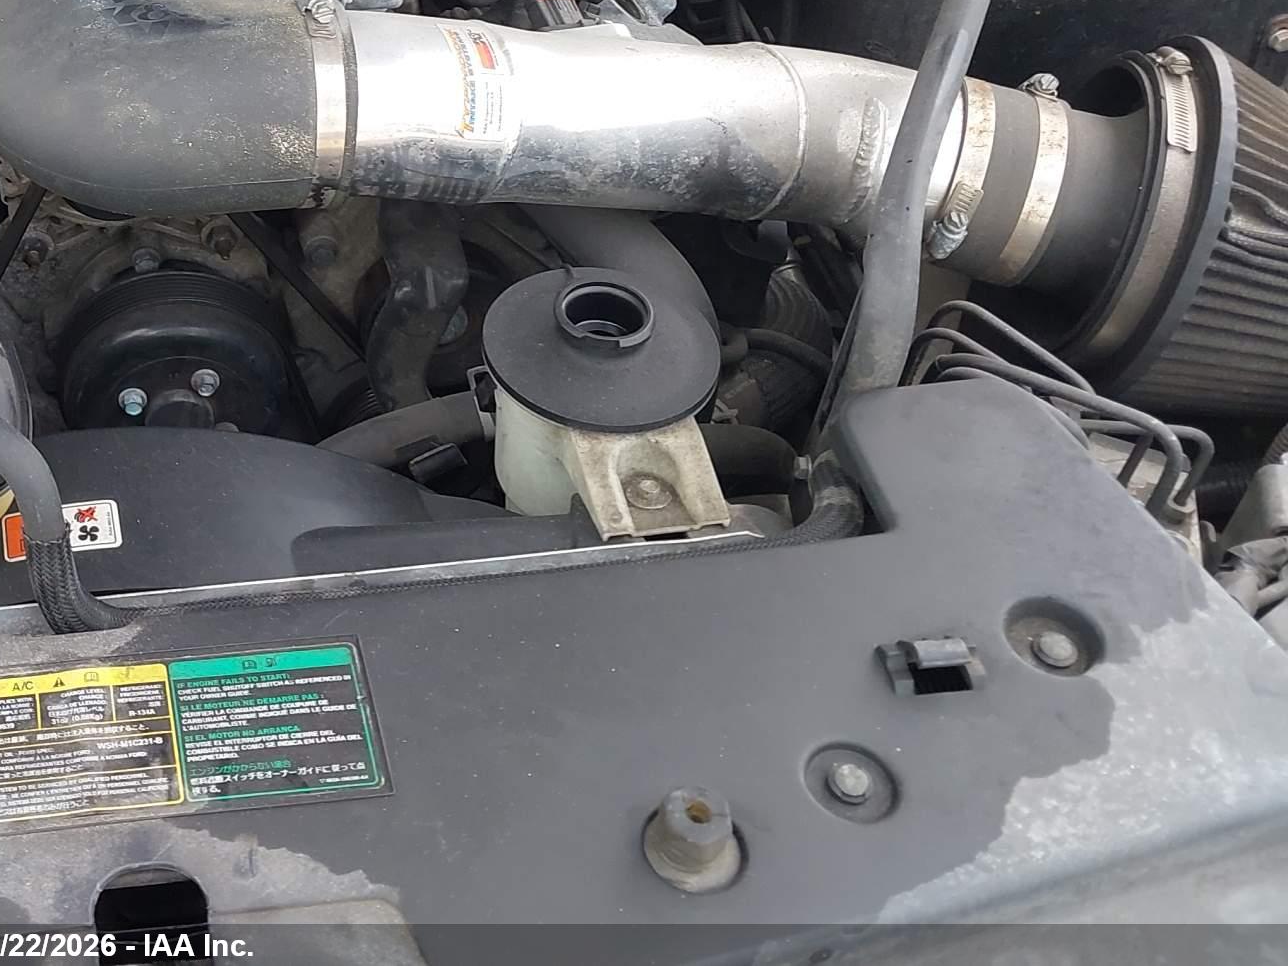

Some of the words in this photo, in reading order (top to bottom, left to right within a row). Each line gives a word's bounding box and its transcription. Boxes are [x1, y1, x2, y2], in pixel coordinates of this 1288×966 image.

[188, 679, 219, 688] ENGINE
[221, 677, 244, 685] FAILS
[261, 673, 290, 681] START:
[295, 675, 342, 685] REFERENCED
[12, 680, 34, 692] A/C
[200, 692, 226, 700] OWNER
[204, 700, 240, 709] MOTEUR
[226, 705, 268, 715] COMMANDE
[282, 700, 316, 709] COUPURE
[230, 713, 257, 721] COMME
[185, 741, 212, 749] REVISE
[225, 735, 277, 745] INTERRUPTOR
[291, 731, 318, 739] CIERRE
[208, 731, 240, 740] MOTOR
[186, 745, 240, 756] COMBUSTIBLE
[277, 739, 303, 747] INDICA
